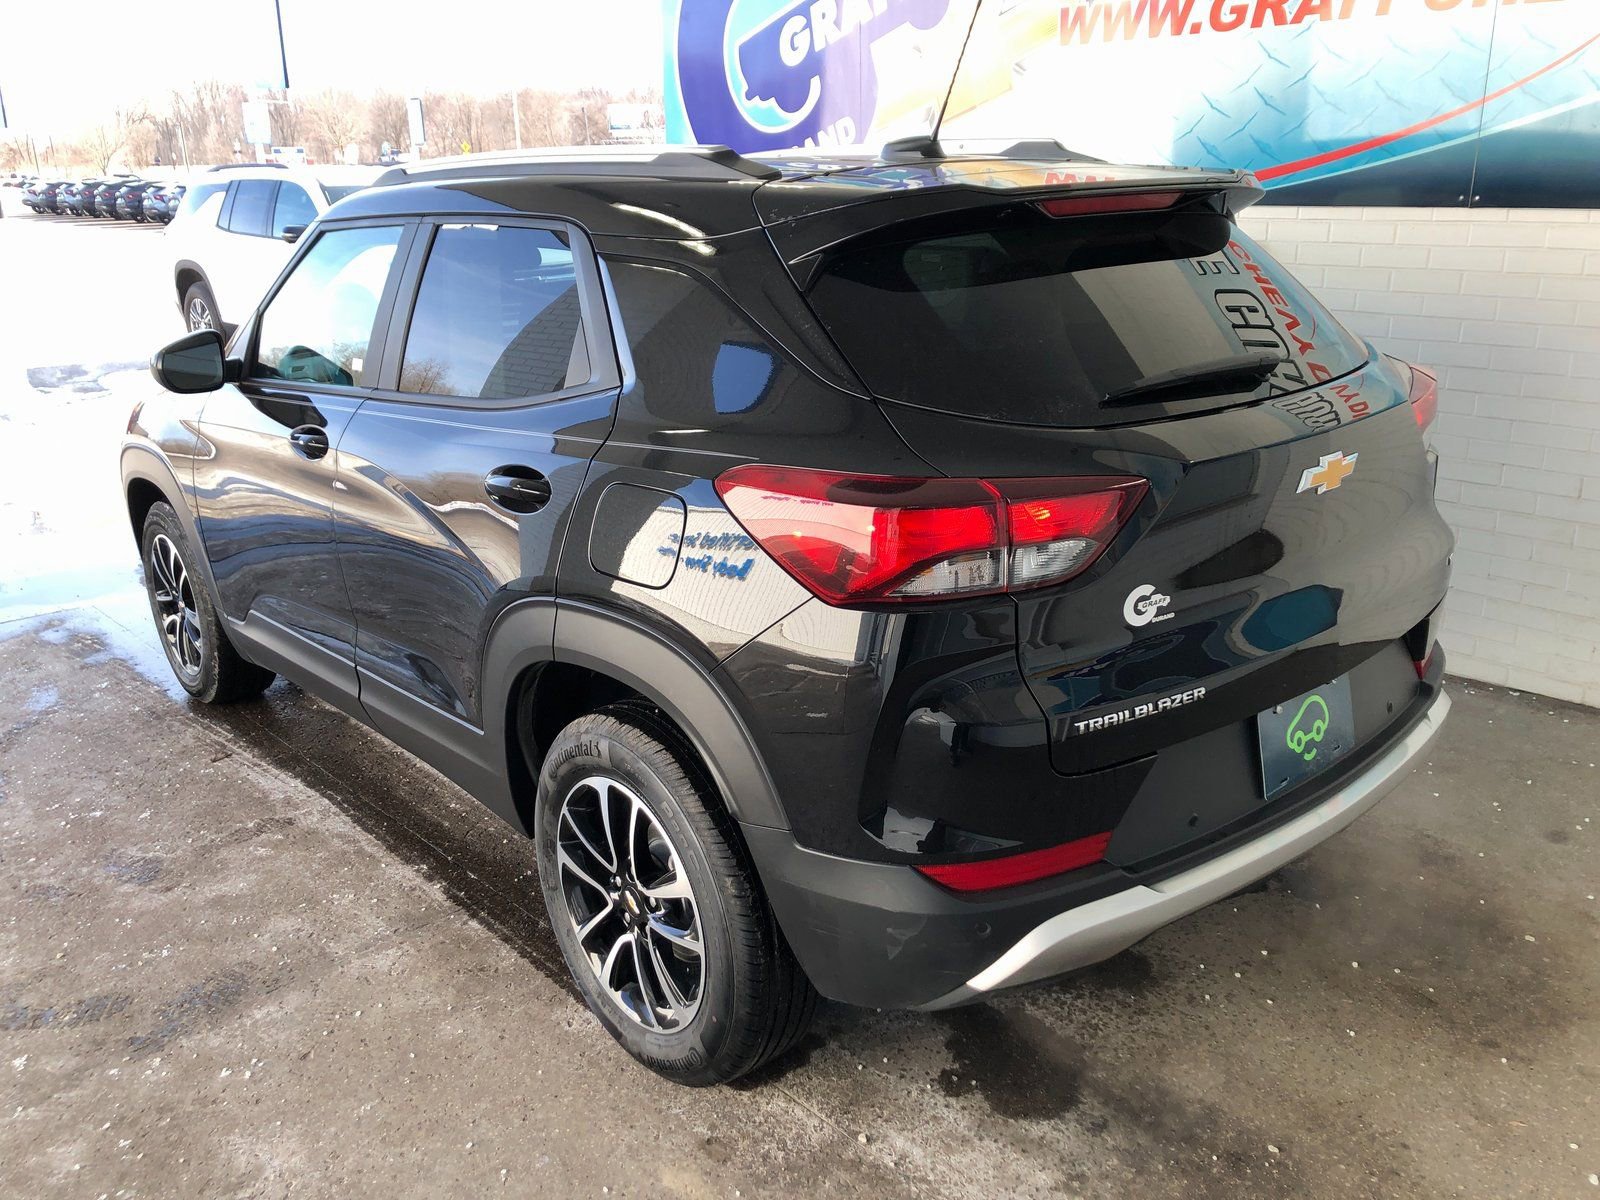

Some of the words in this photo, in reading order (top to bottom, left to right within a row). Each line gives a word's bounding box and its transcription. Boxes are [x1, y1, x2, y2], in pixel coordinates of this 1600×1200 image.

[1142, 597, 1167, 609] GRAFF
[1151, 612, 1175, 623] DURAND
[1074, 687, 1206, 735] TRAILBLAZER
[547, 740, 593, 779] Continental
